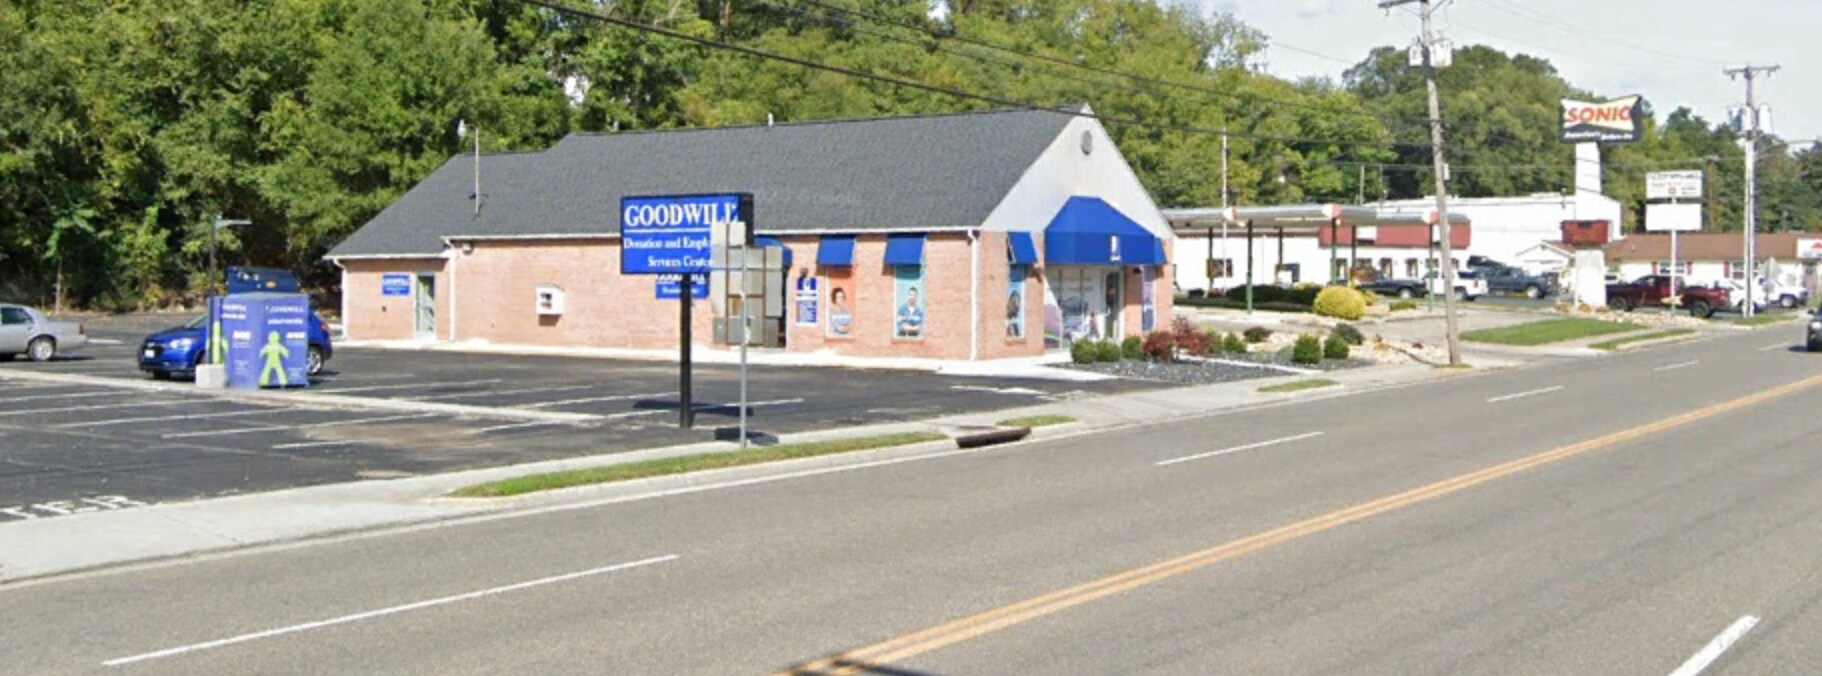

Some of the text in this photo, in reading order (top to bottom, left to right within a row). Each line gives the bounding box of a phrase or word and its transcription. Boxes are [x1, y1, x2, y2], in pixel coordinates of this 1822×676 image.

[1567, 105, 1631, 123] SONIC
[624, 203, 739, 227] GOODWILL
[623, 237, 662, 249] Donation
[665, 236, 681, 249] and
